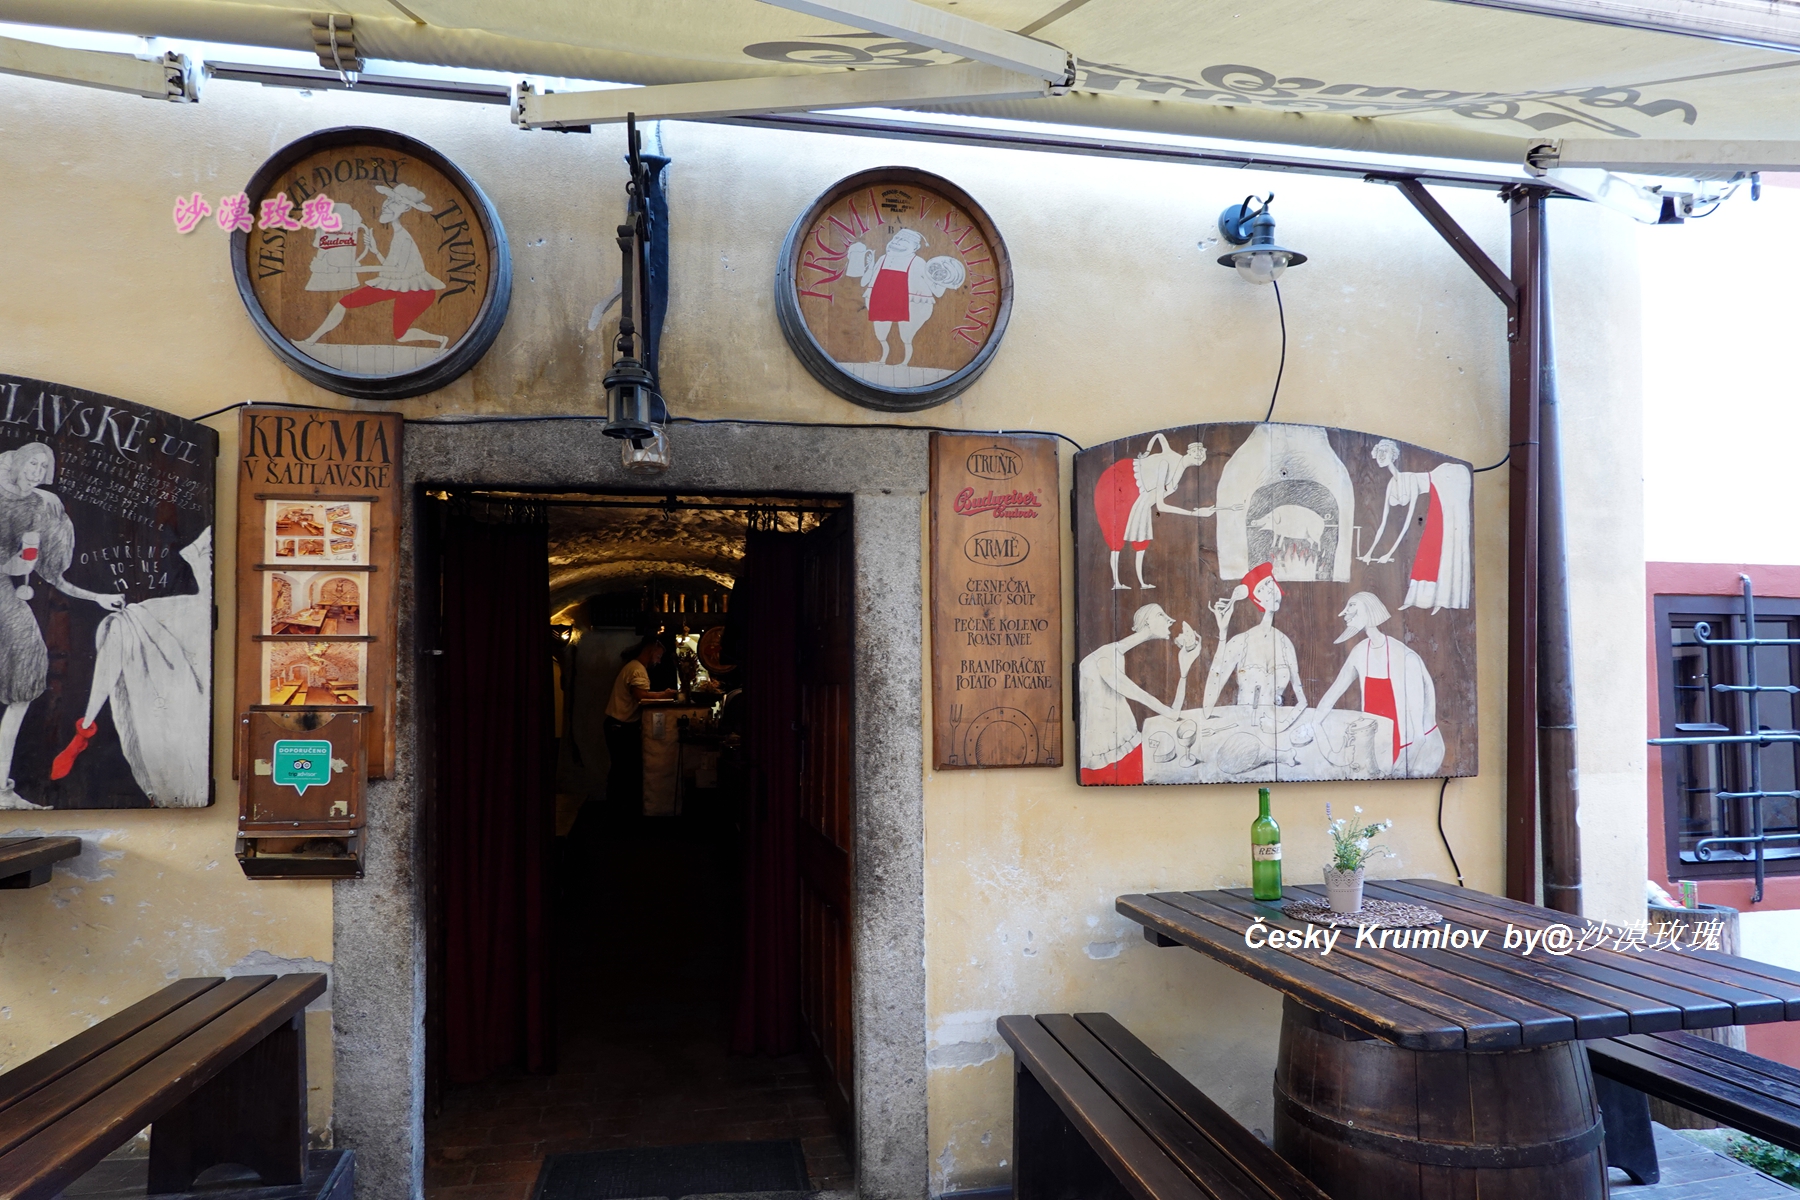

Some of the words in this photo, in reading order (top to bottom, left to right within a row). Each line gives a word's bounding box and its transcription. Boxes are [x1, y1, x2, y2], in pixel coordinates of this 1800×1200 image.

[918, 194, 937, 222] V
[245, 414, 393, 465] KRČMA
[161, 433, 200, 467] UL.
[244, 459, 255, 483] V
[971, 453, 1018, 475] TRUŇK
[953, 486, 1042, 512] Budweiser
[993, 504, 1038, 518] Budvar
[80, 540, 170, 564] OTEVŘENO
[973, 536, 1021, 558] KRMĚ
[148, 572, 168, 590] 24
[966, 577, 1032, 593] ČESNEČKA
[958, 592, 1002, 606] GARLIC
[1006, 592, 1036, 606] SOUP
[954, 616, 996, 632] PEČENÉ
[999, 617, 1049, 632] KOLENO
[967, 633, 1002, 647] ROAST
[1005, 633, 1032, 647] KNEE
[961, 656, 1046, 675] BRAMBORÁČKY
[956, 674, 997, 690] POTATO
[1004, 674, 1052, 690] PANCAKE
